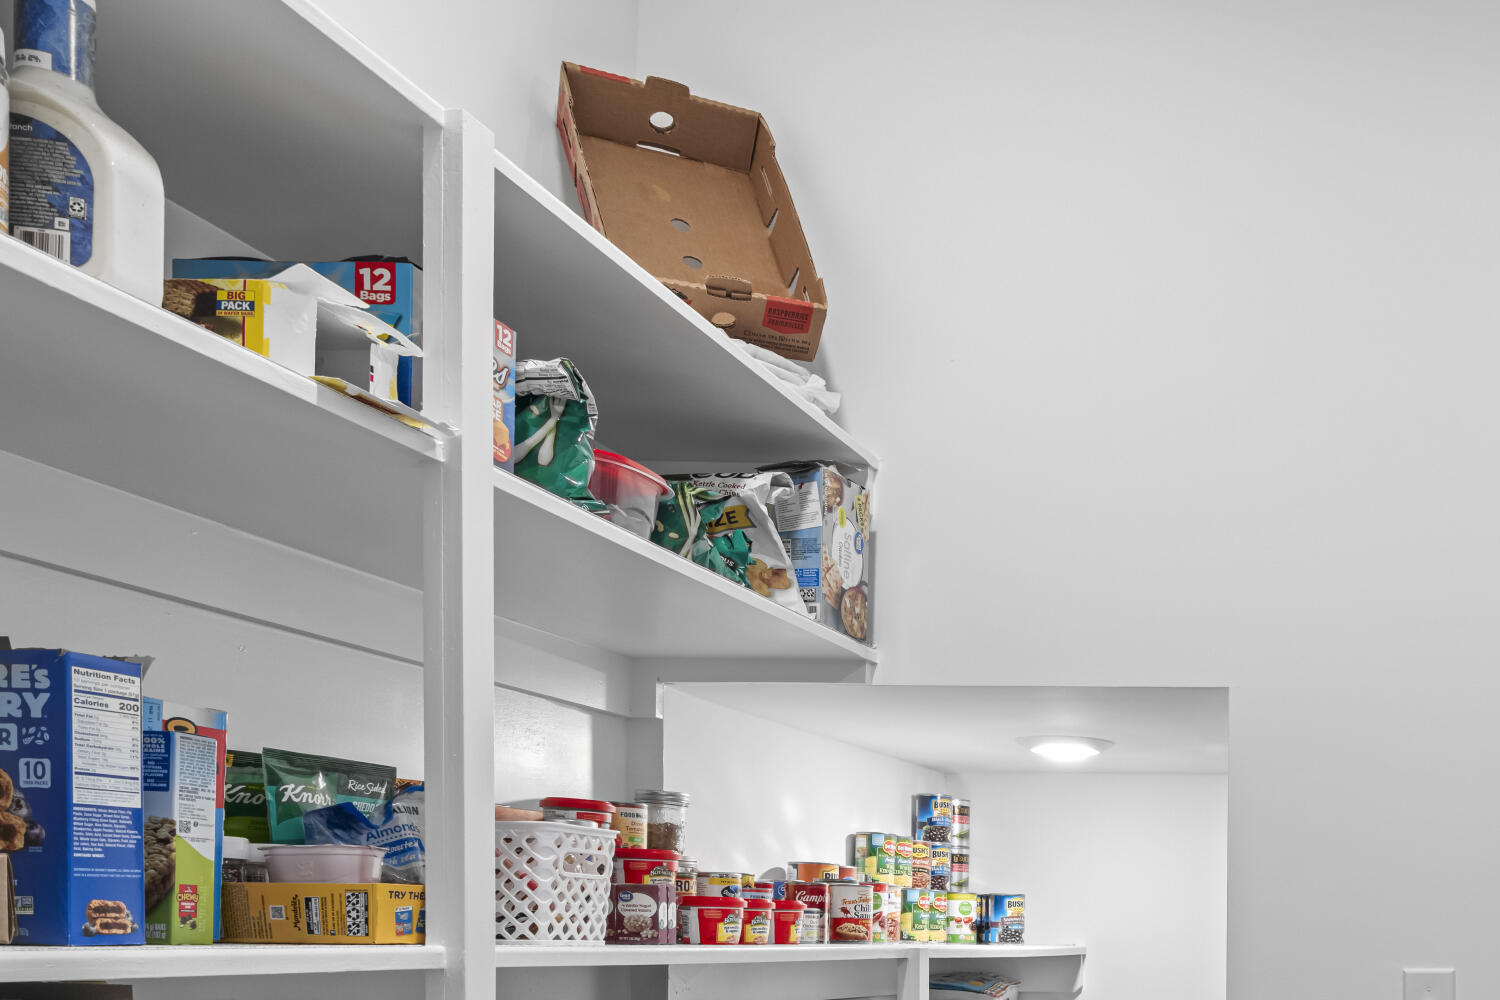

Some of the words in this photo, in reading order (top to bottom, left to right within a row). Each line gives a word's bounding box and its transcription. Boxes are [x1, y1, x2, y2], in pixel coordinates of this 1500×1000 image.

[359, 267, 391, 291] 12
[226, 291, 246, 300] BIG
[360, 290, 391, 303] Bags
[221, 301, 251, 311] PACK
[496, 324, 512, 348] 12
[717, 481, 747, 490] Cooked
[843, 532, 851, 579] Saltine
[73, 668, 112, 681] Nutrition
[114, 674, 136, 685] Facts
[73, 697, 109, 709] Calories
[118, 702, 140, 713] 200
[24, 760, 46, 780] 10
[347, 779, 366, 792] Rice
[366, 822, 421, 842] Almonds
[388, 890, 407, 900] TRY
